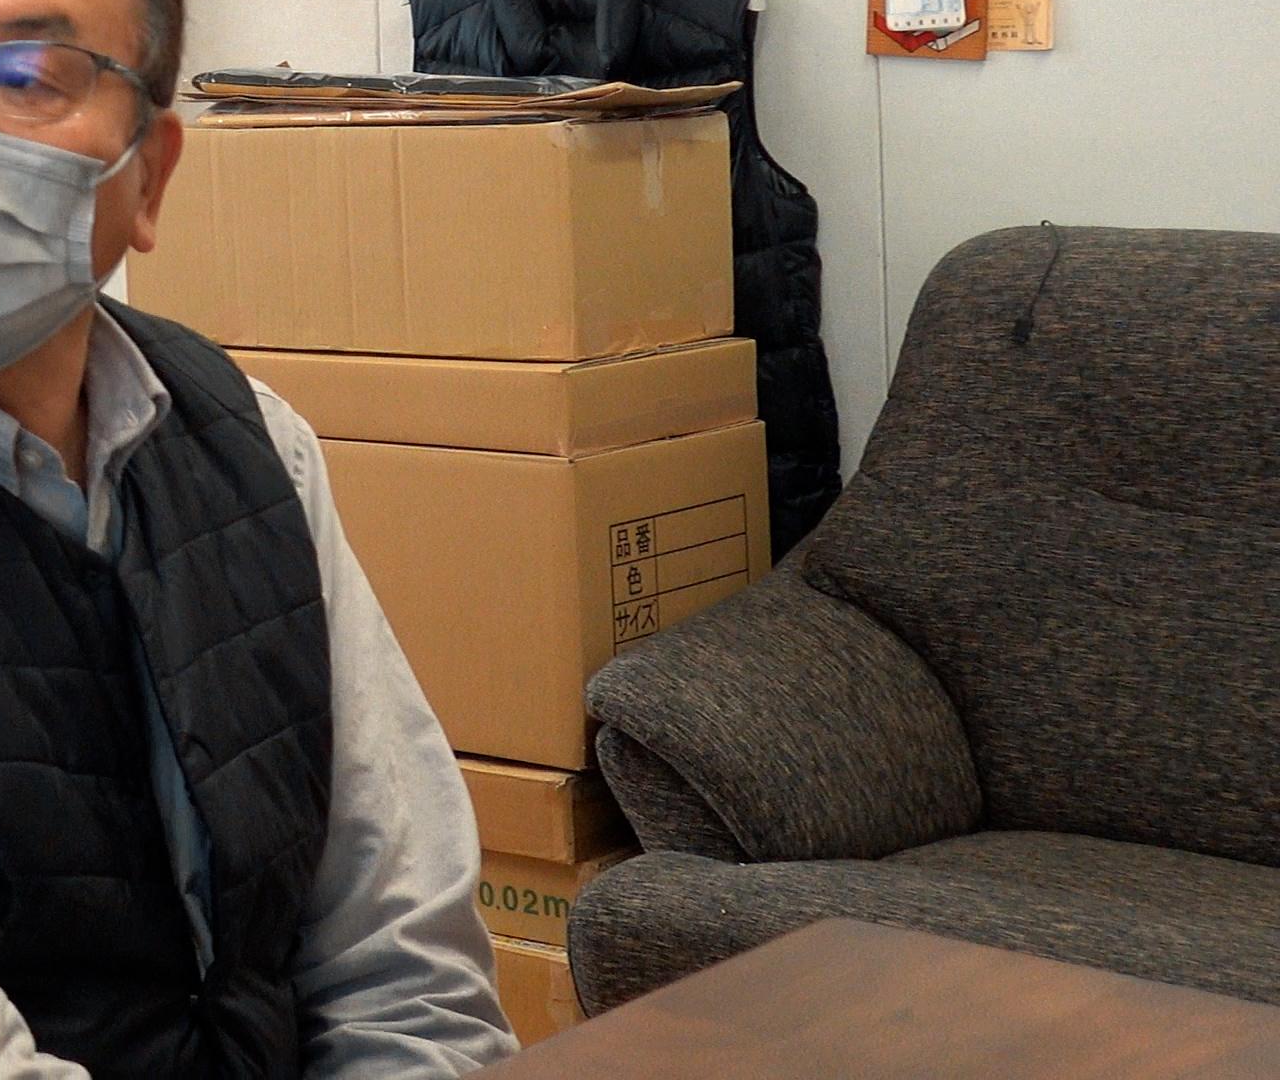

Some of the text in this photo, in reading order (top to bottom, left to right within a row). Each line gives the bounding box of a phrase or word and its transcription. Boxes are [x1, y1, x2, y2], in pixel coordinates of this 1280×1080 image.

[616, 521, 652, 559] 品番
[626, 566, 643, 597] 色
[616, 601, 657, 640] サイズ
